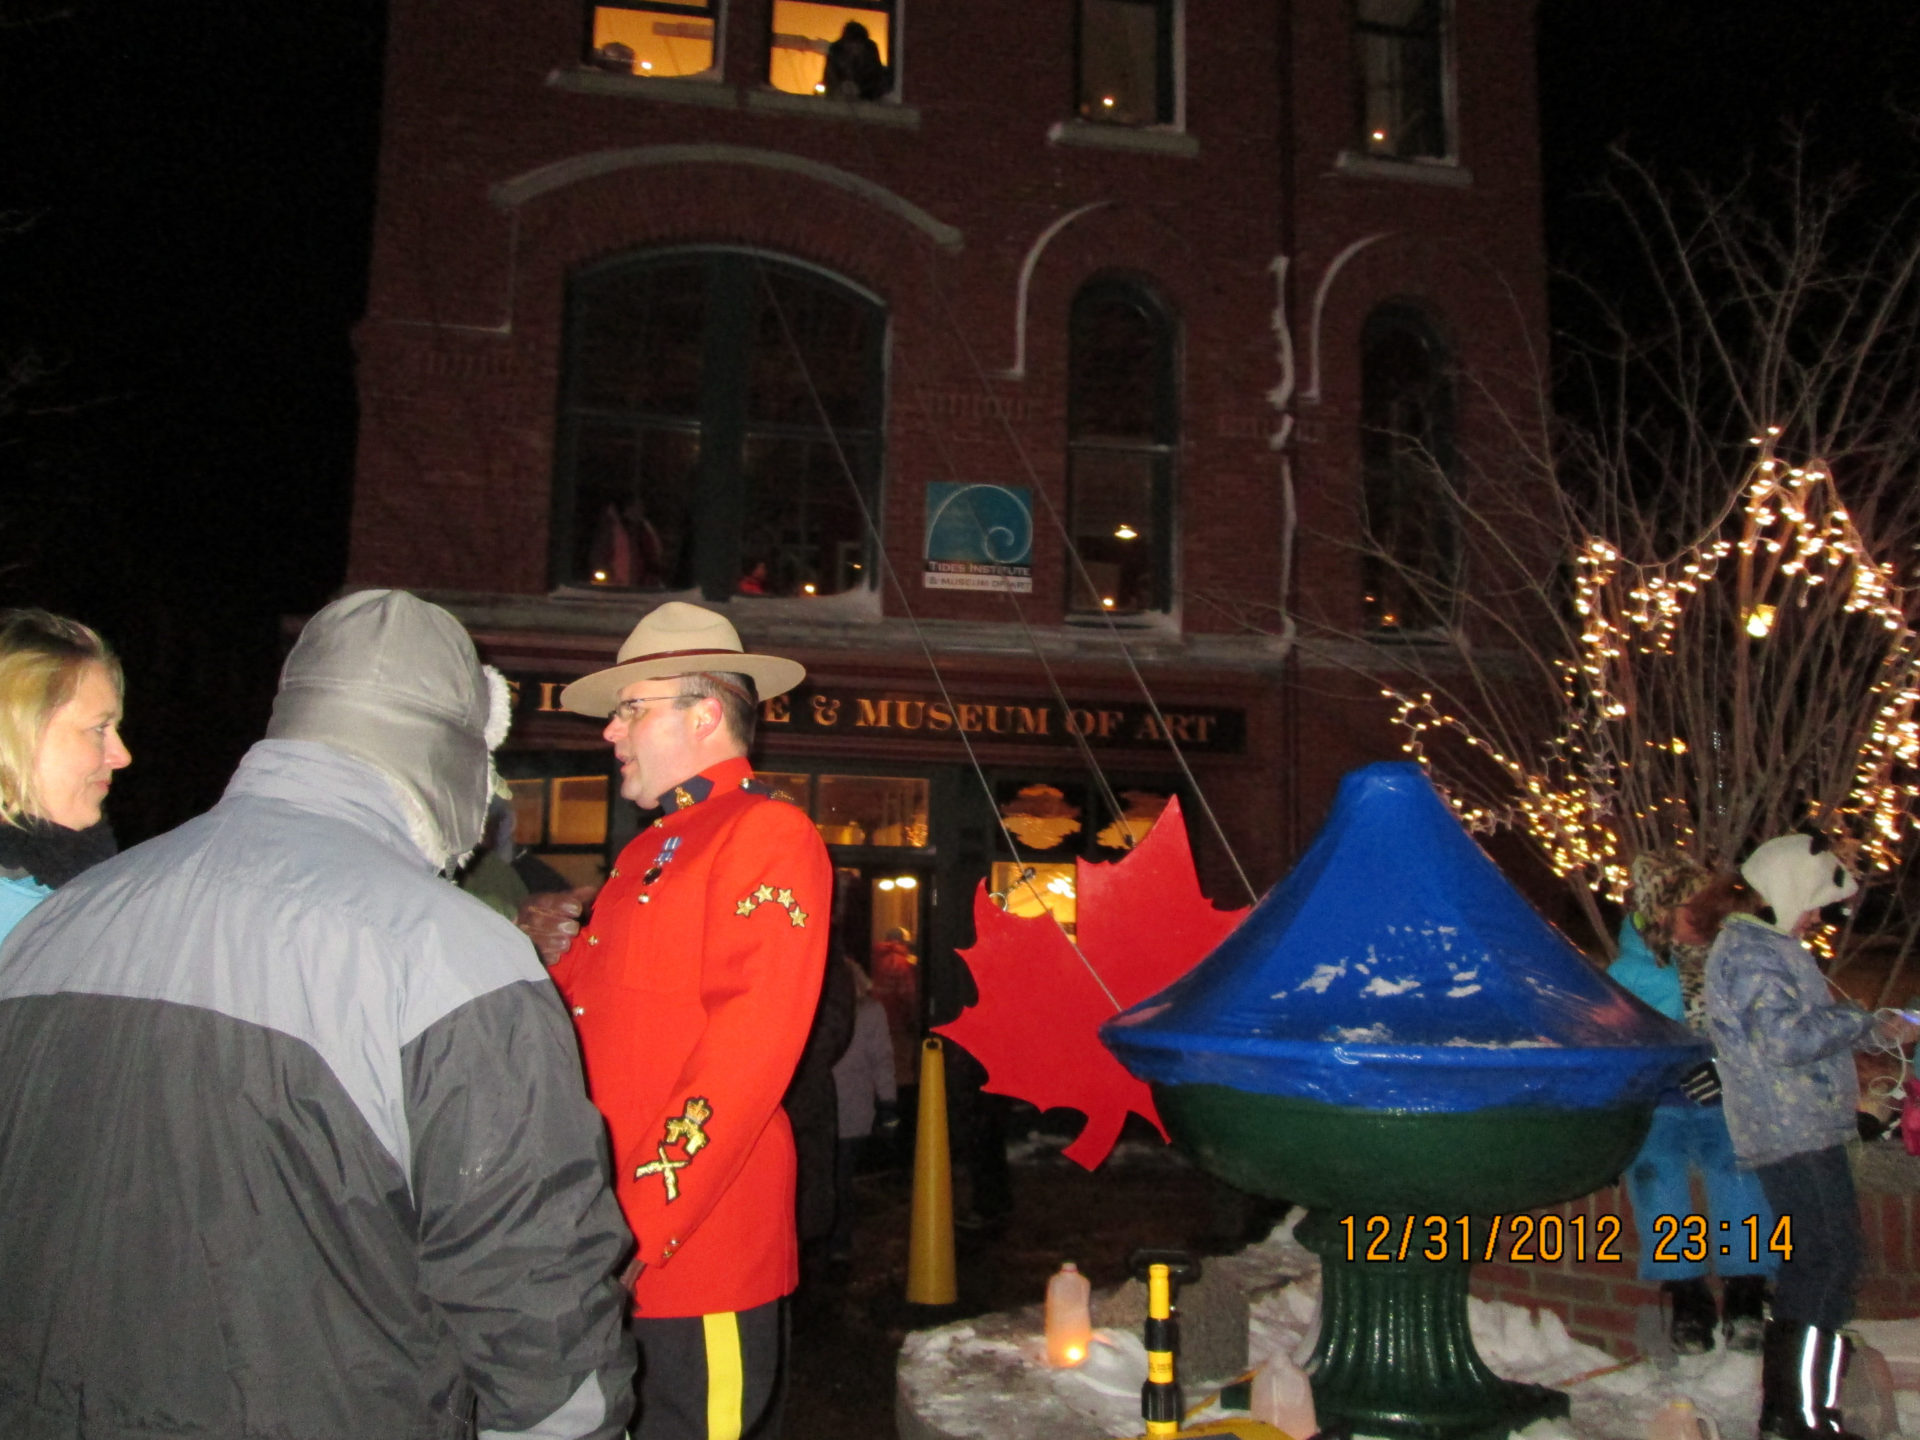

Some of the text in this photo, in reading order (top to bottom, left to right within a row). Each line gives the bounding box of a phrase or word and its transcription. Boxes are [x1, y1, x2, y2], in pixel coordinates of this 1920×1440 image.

[928, 561, 1031, 577] TIDES INSTITUTE
[929, 576, 937, 585] &
[940, 577, 989, 588] MUSEUM
[811, 694, 841, 726] &
[856, 698, 1051, 736] MUSEUM
[1065, 708, 1124, 738] OF
[1136, 713, 1216, 742] ART
